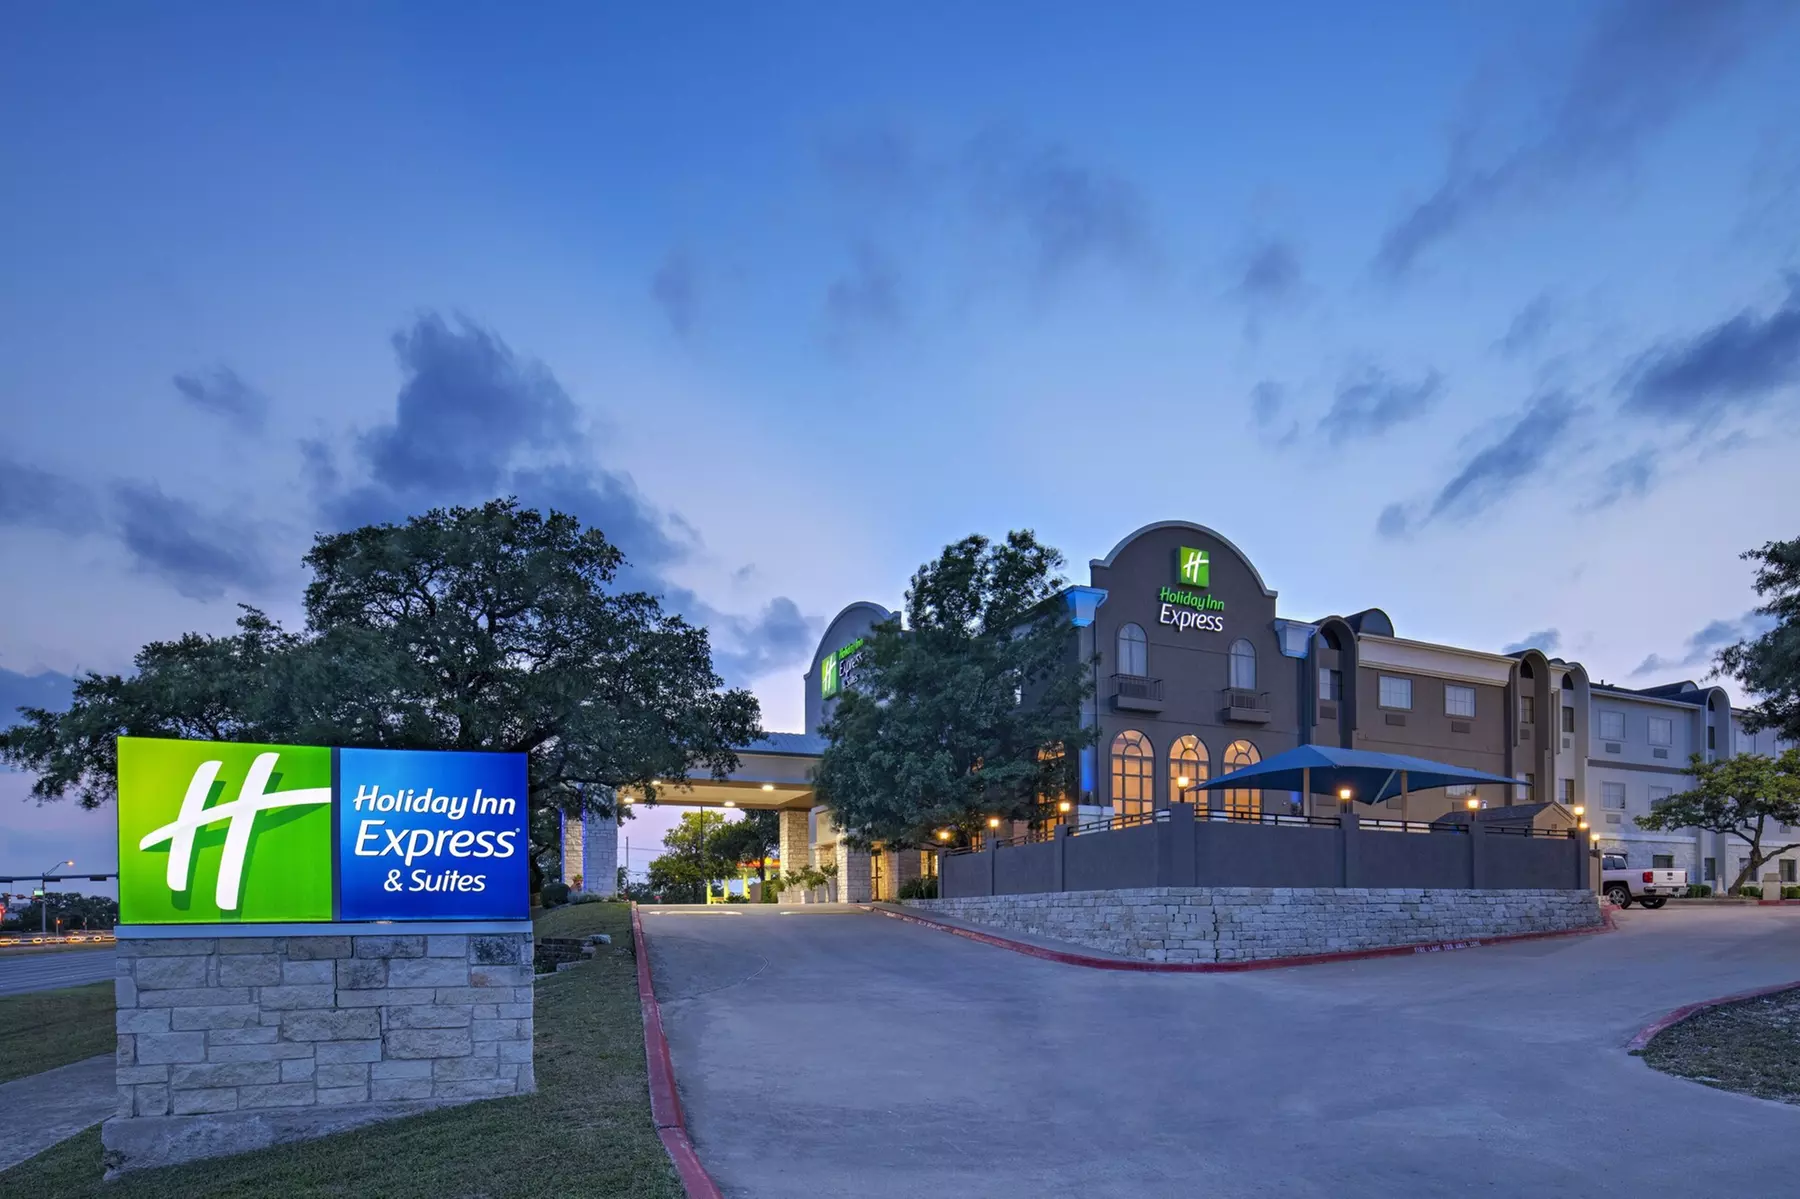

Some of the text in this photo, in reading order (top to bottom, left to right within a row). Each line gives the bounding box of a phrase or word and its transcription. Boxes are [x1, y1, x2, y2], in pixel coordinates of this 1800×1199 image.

[1160, 587, 1225, 611] Holiday Inn
[1160, 604, 1223, 632] Express
[353, 784, 516, 819] Holiday Inn
[354, 820, 517, 866] Express
[383, 869, 486, 892] & Suites
